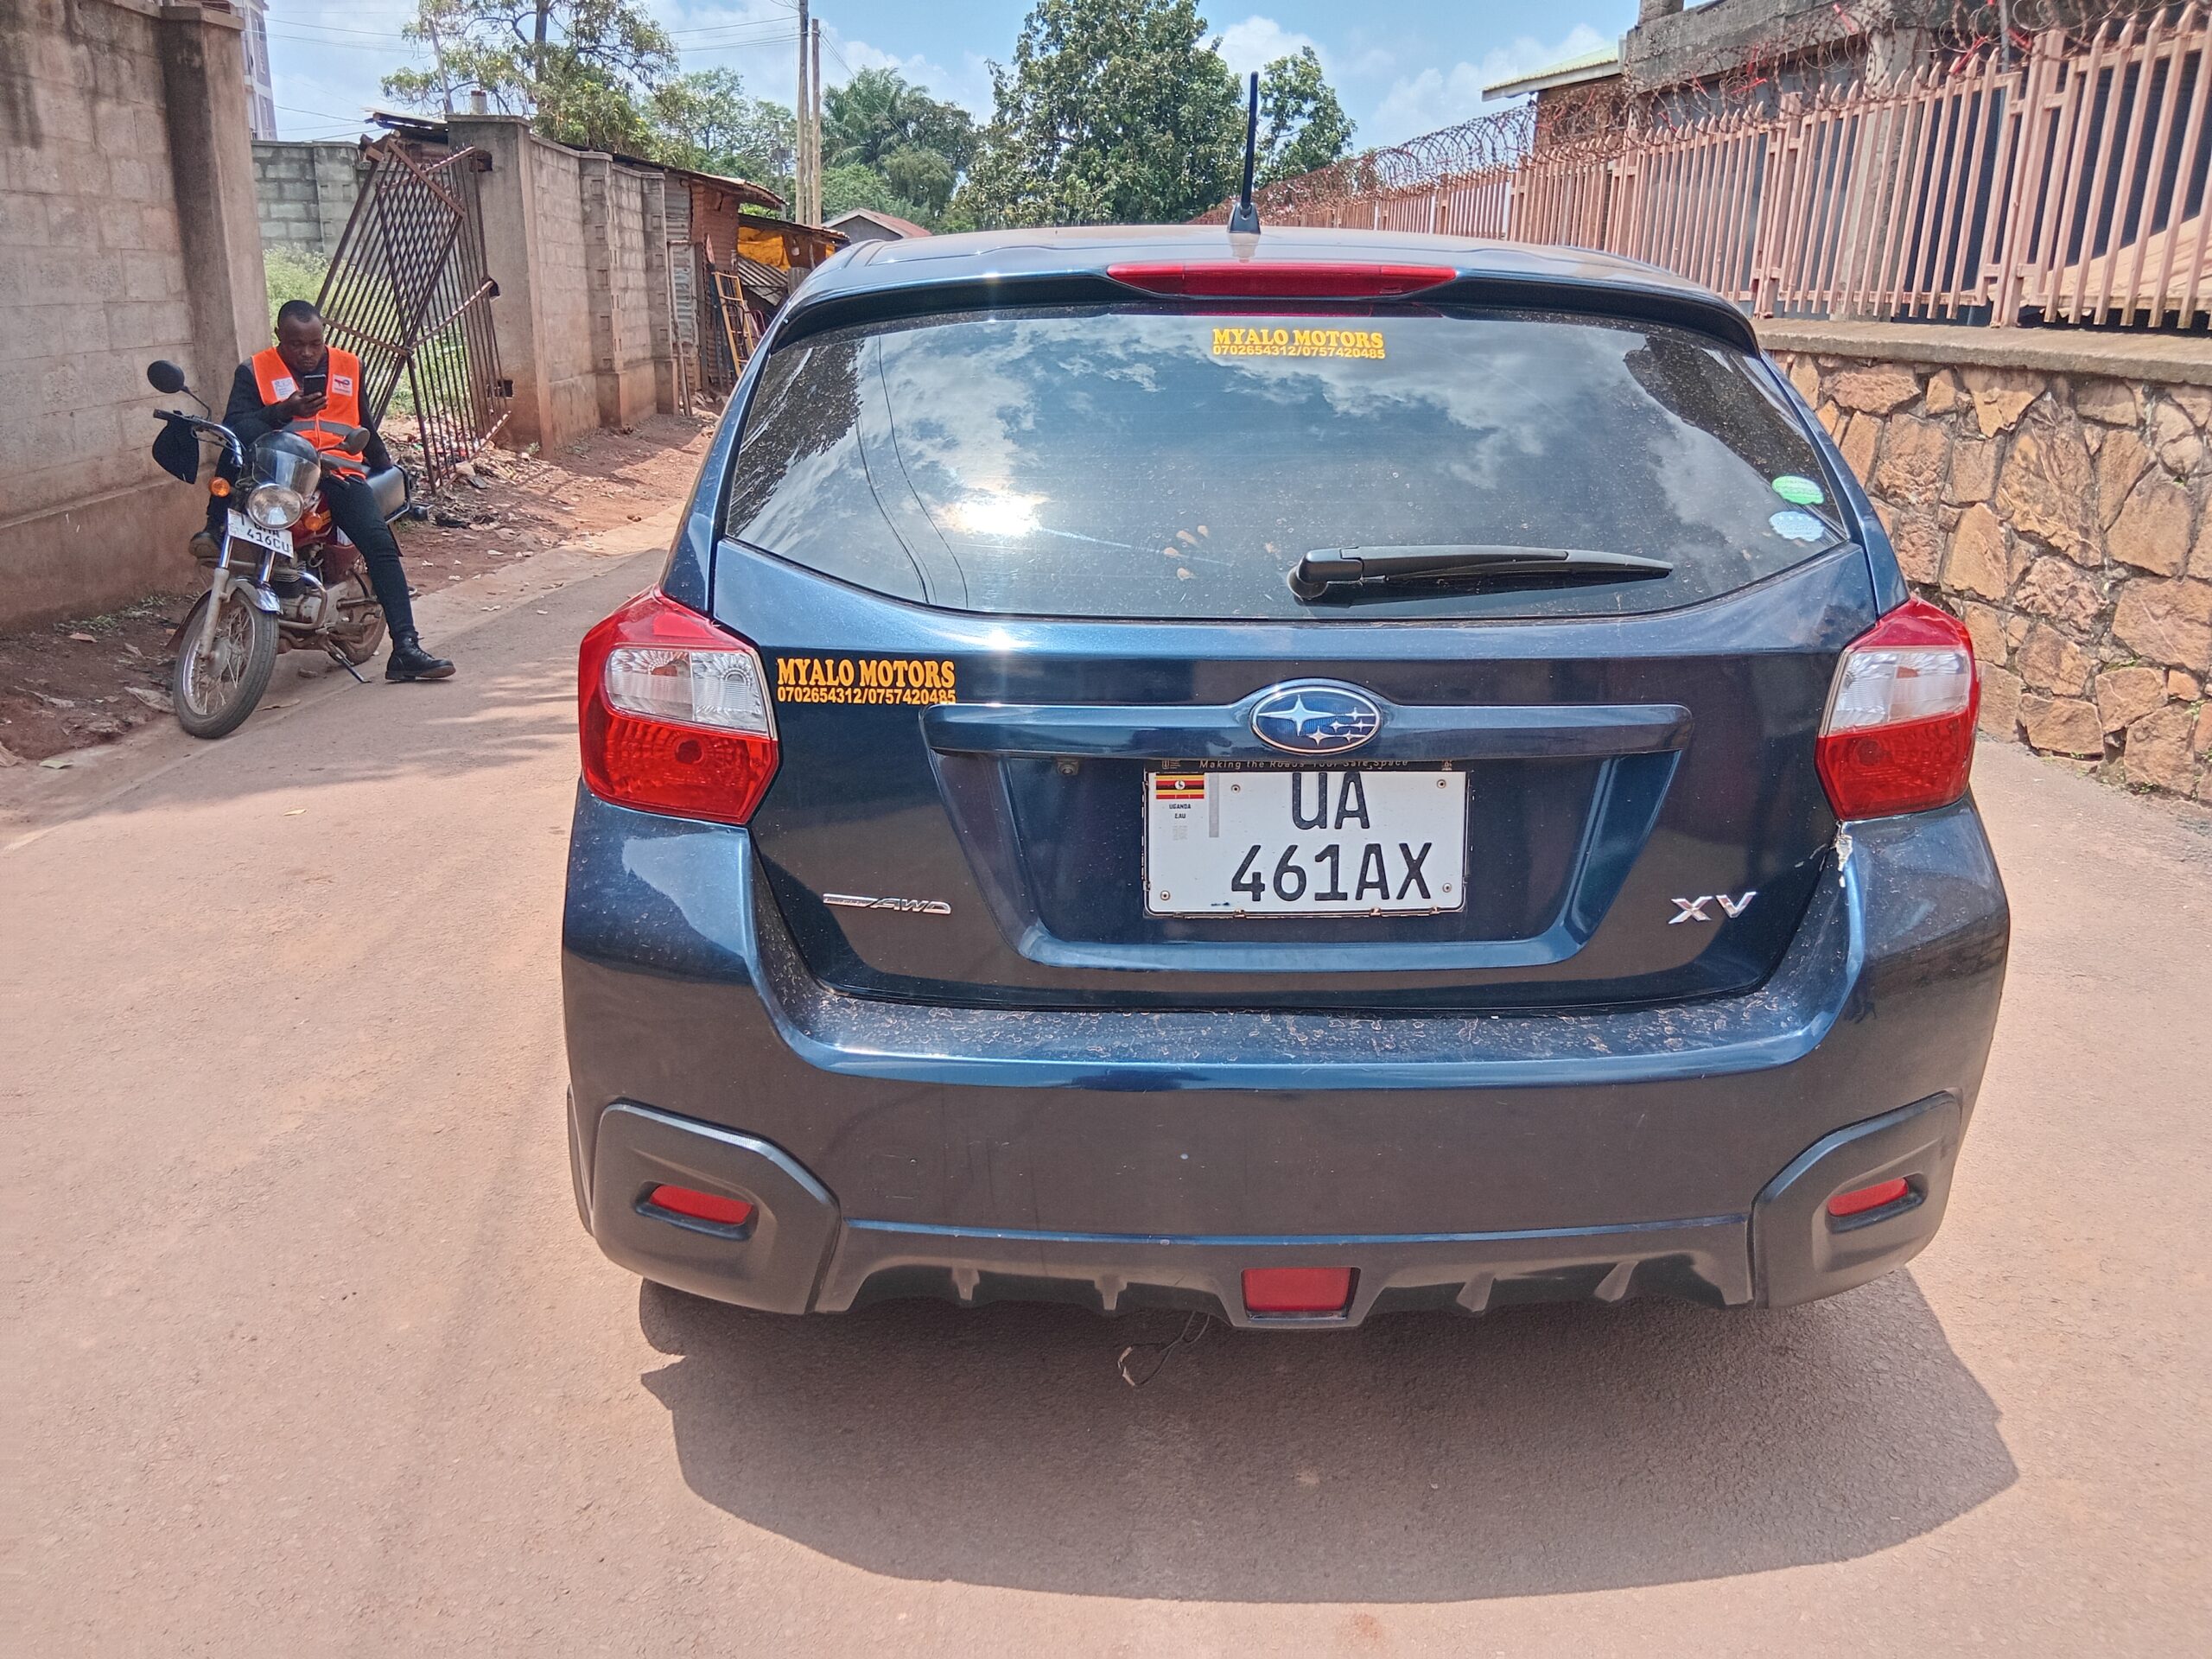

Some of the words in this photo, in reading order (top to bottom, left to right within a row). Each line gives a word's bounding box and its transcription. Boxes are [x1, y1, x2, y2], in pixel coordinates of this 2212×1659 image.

[1212, 328, 1288, 346] MYALO
[1293, 329, 1384, 349] MOTORS
[1213, 346, 1386, 359] 0702654312/0757420485
[247, 528, 289, 552] 416CU
[778, 658, 855, 687] MYALO
[859, 659, 956, 689] MOTORS
[778, 687, 957, 704] 0702654312/0757420485
[1199, 760, 1242, 770] Making
[1247, 760, 1265, 768] the
[1292, 772, 1370, 830] UA
[1230, 842, 1433, 902] 461AX
[870, 897, 951, 915] AWD
[1668, 891, 1758, 925] XV
